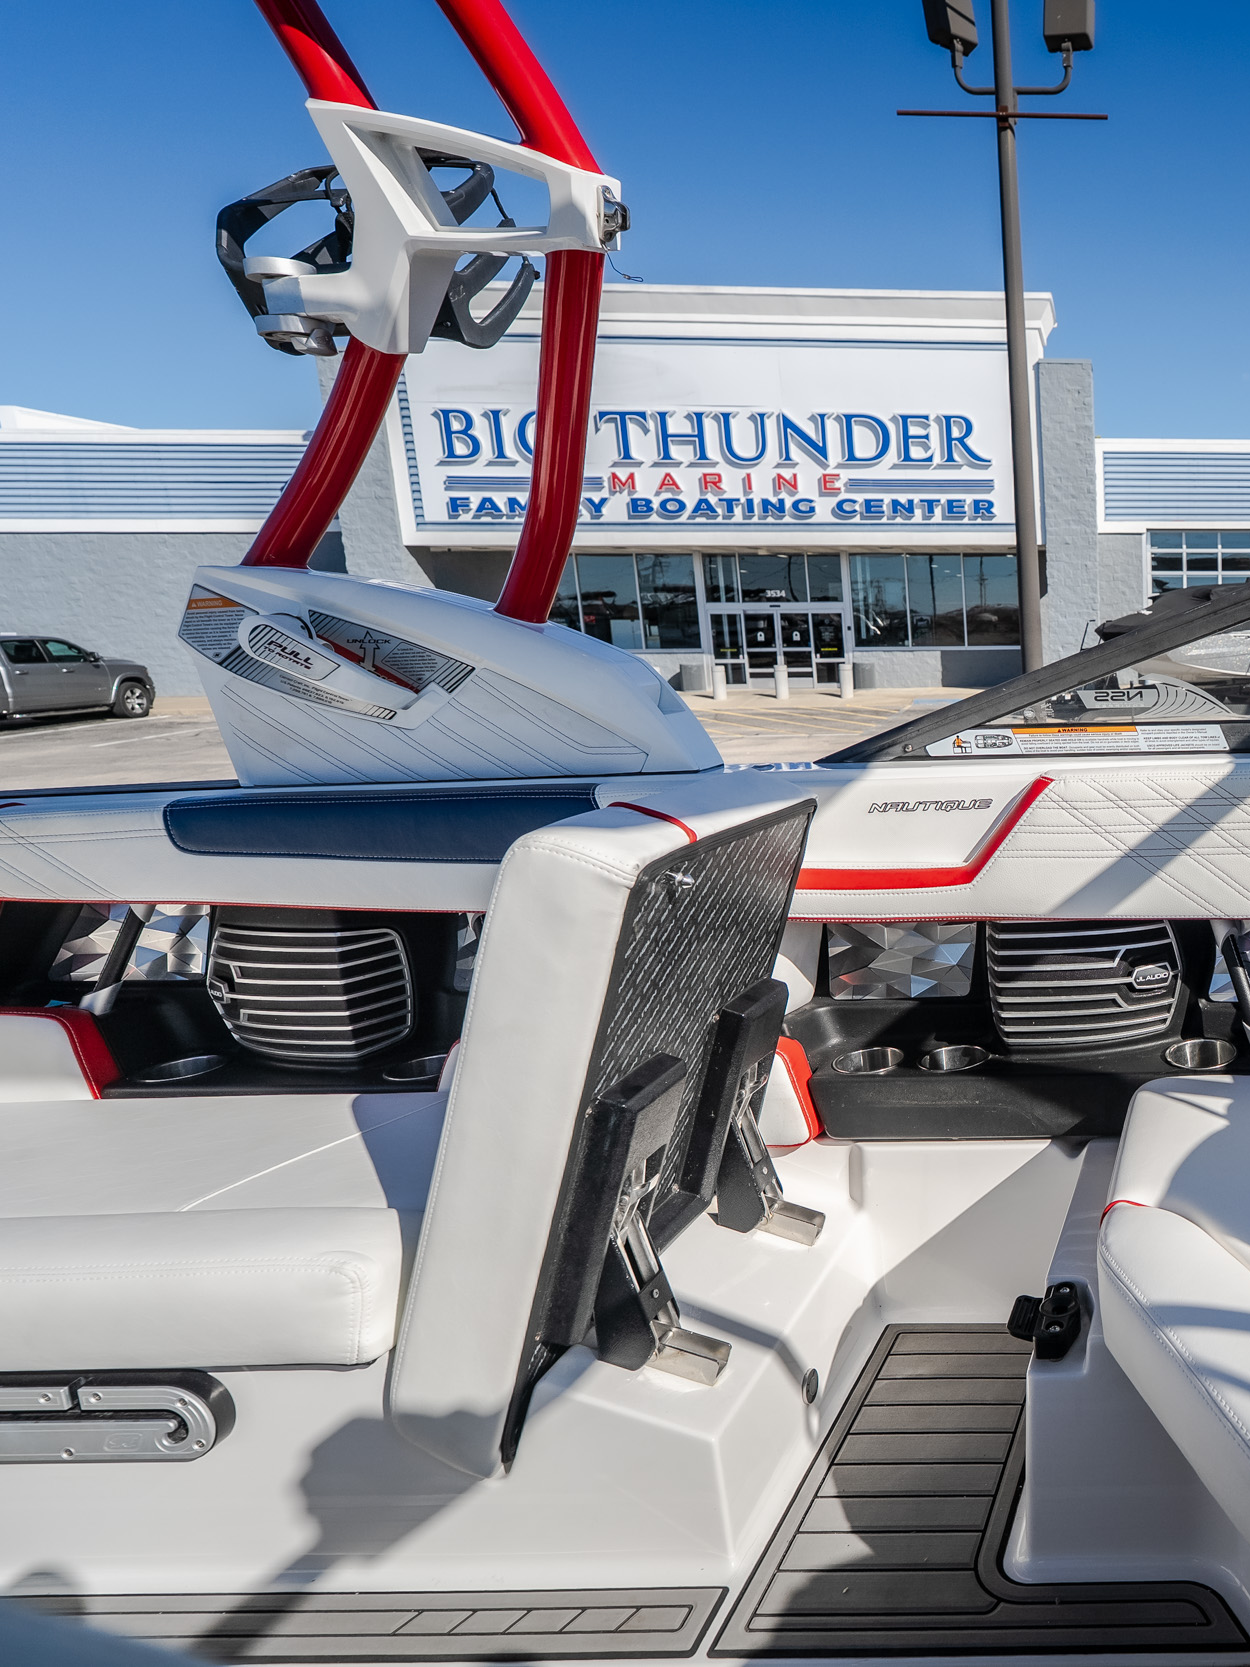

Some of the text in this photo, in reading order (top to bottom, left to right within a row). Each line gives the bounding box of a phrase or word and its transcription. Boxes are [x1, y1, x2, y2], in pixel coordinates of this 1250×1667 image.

[596, 410, 993, 468] THUNDER
[608, 471, 842, 495] MARINE
[447, 496, 996, 519] FAMY BOATING CENTER
[766, 590, 786, 598] 3534
[263, 645, 312, 671] TO ROTATE
[267, 640, 313, 666] PULL
[867, 798, 993, 814] NAUTIQUE
[1146, 972, 1168, 980] AUDIO
